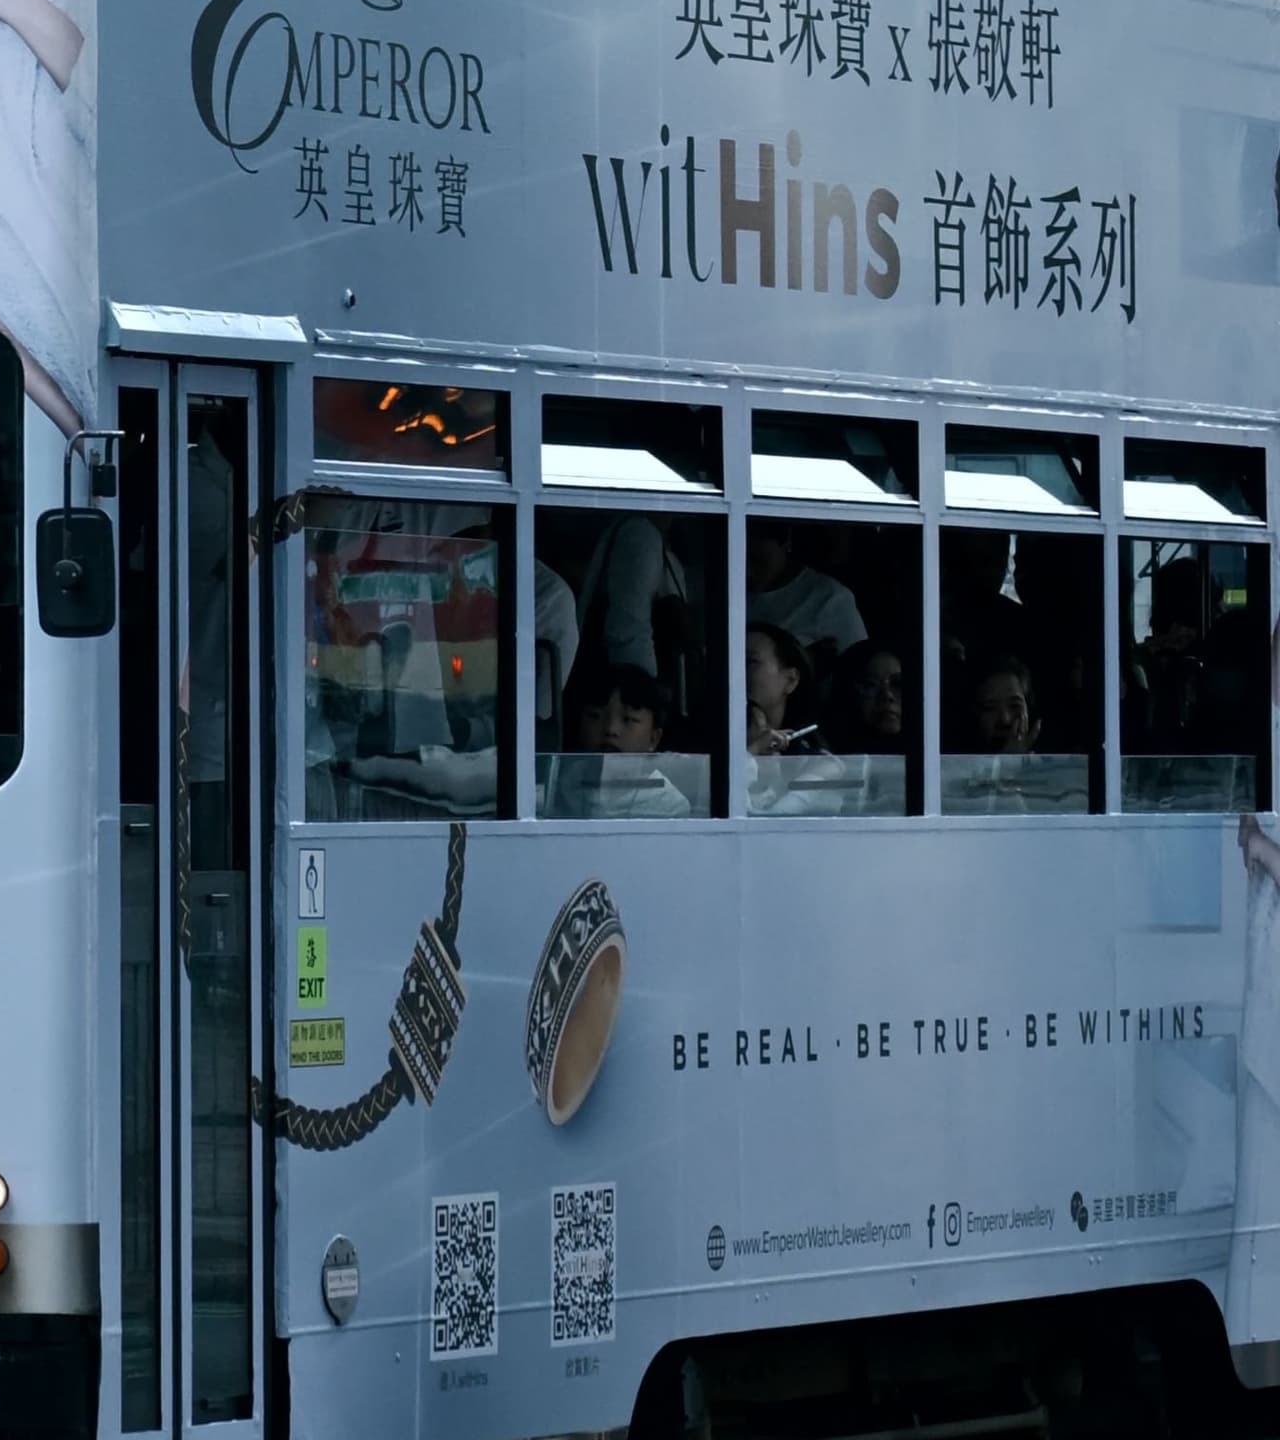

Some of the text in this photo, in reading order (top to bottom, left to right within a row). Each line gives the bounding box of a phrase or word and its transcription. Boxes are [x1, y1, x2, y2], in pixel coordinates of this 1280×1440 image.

[294, 137, 469, 237] 英皇珠寶
[583, 123, 901, 300] witHins
[923, 169, 1136, 324] 首飾系列
[299, 978, 325, 998] EXIT
[308, 1051, 321, 1062] THE
[673, 1004, 1205, 1071] BE REAL BE TRUE BE WITHINS
[733, 1221, 912, 1256] www.EmperorWatchJewellery.com
